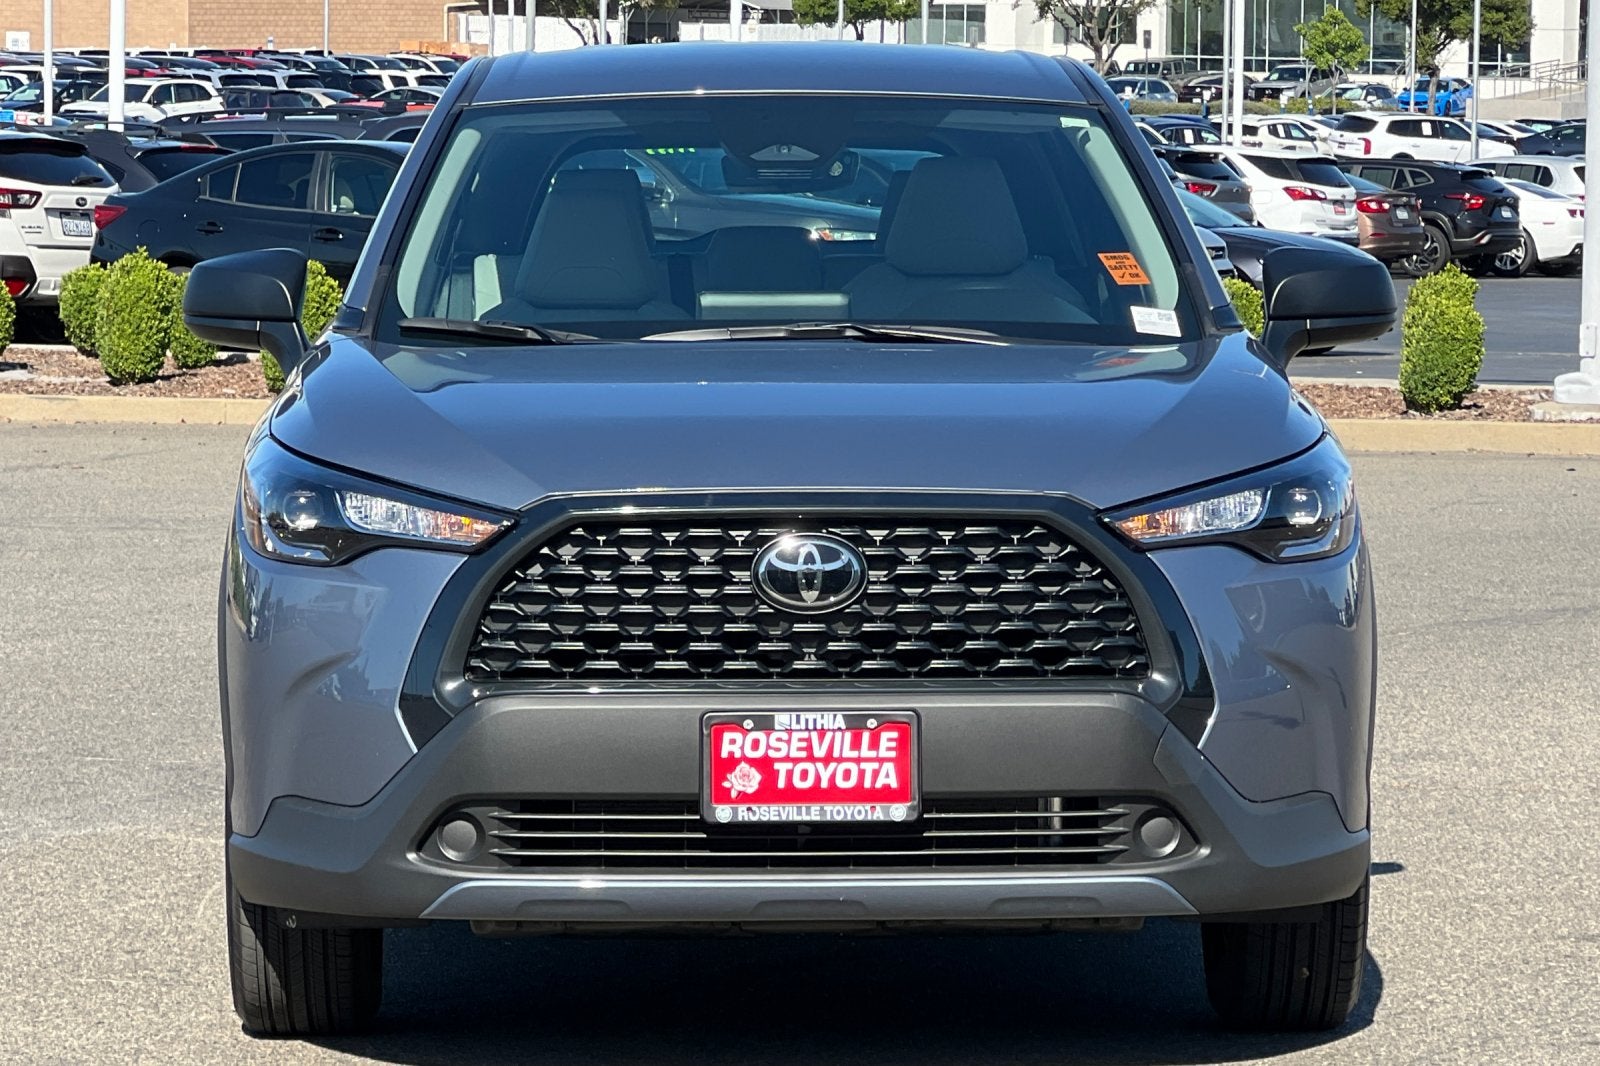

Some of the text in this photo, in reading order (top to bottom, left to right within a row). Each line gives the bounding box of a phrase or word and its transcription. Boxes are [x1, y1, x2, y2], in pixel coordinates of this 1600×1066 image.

[791, 713, 847, 730] LITHIA
[720, 731, 899, 759] ROSEVILLE
[773, 761, 899, 789] TOYOTA
[737, 805, 884, 821] ROSEVILLE TOYOTA
